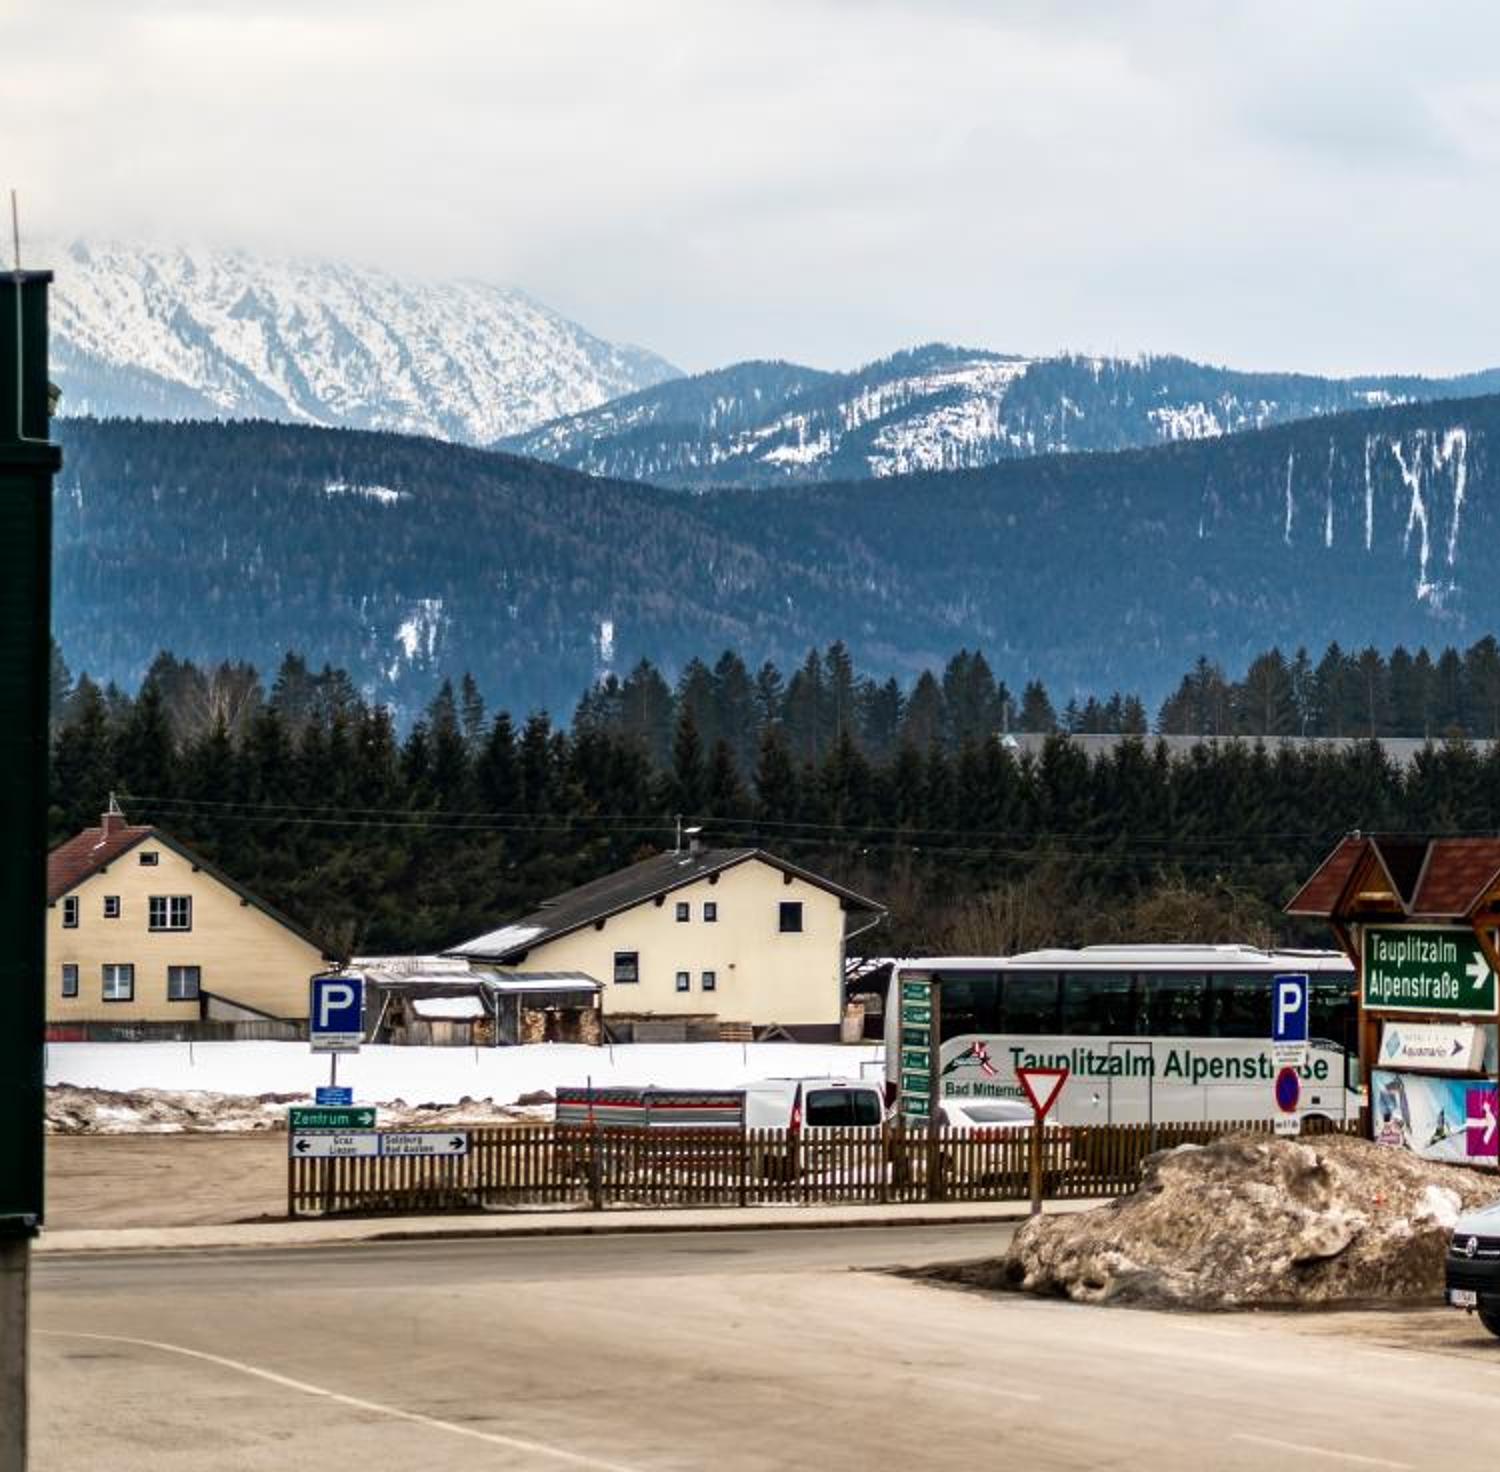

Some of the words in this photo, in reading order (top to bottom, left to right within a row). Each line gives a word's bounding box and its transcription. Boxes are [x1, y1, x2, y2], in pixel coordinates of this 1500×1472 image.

[1371, 933, 1457, 968] Tauplitzalm
[1369, 969, 1459, 1003] Alpenstraße
[320, 984, 354, 1027] P
[1277, 983, 1302, 1035] P
[1163, 1049, 1329, 1085] Alpenstrße
[945, 1081, 969, 1096] Bad
[293, 1111, 350, 1125] Zentrum
